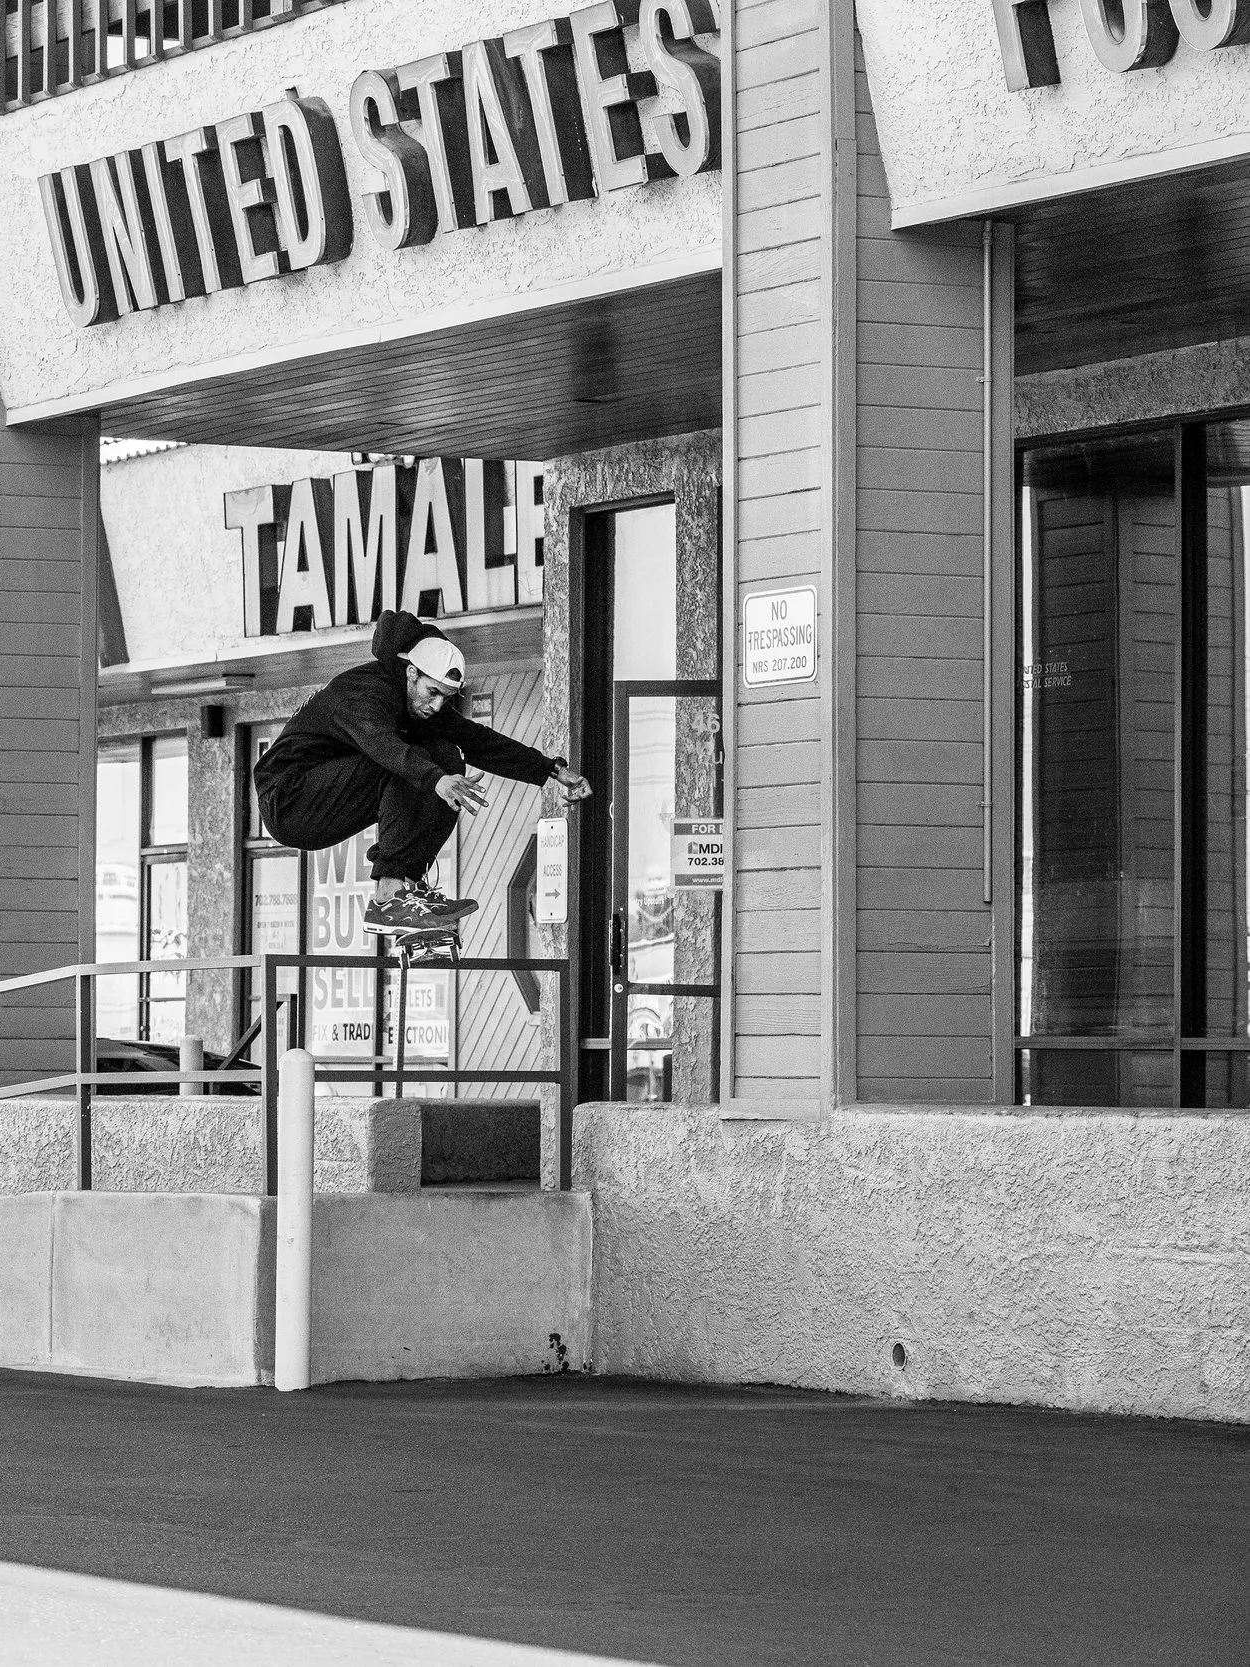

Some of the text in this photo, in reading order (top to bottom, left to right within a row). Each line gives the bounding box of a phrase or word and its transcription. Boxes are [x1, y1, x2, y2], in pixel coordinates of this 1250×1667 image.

[38, 0, 722, 328] UNITED STATES
[771, 600, 787, 620] NO
[748, 624, 812, 651] TRESPASSING
[752, 656, 807, 674] NRS 207.200
[1045, 661, 1068, 673] STATES
[1044, 675, 1072, 688] SERVICE
[691, 824, 716, 834] FOR
[540, 834, 565, 849] HANDICAP
[543, 863, 562, 878] ACCESS
[313, 967, 375, 1010] SELL
[388, 986, 432, 1008] TLETS
[313, 1022, 374, 1042] FIX & TRAD
[388, 1026, 447, 1045] ECTRONI
